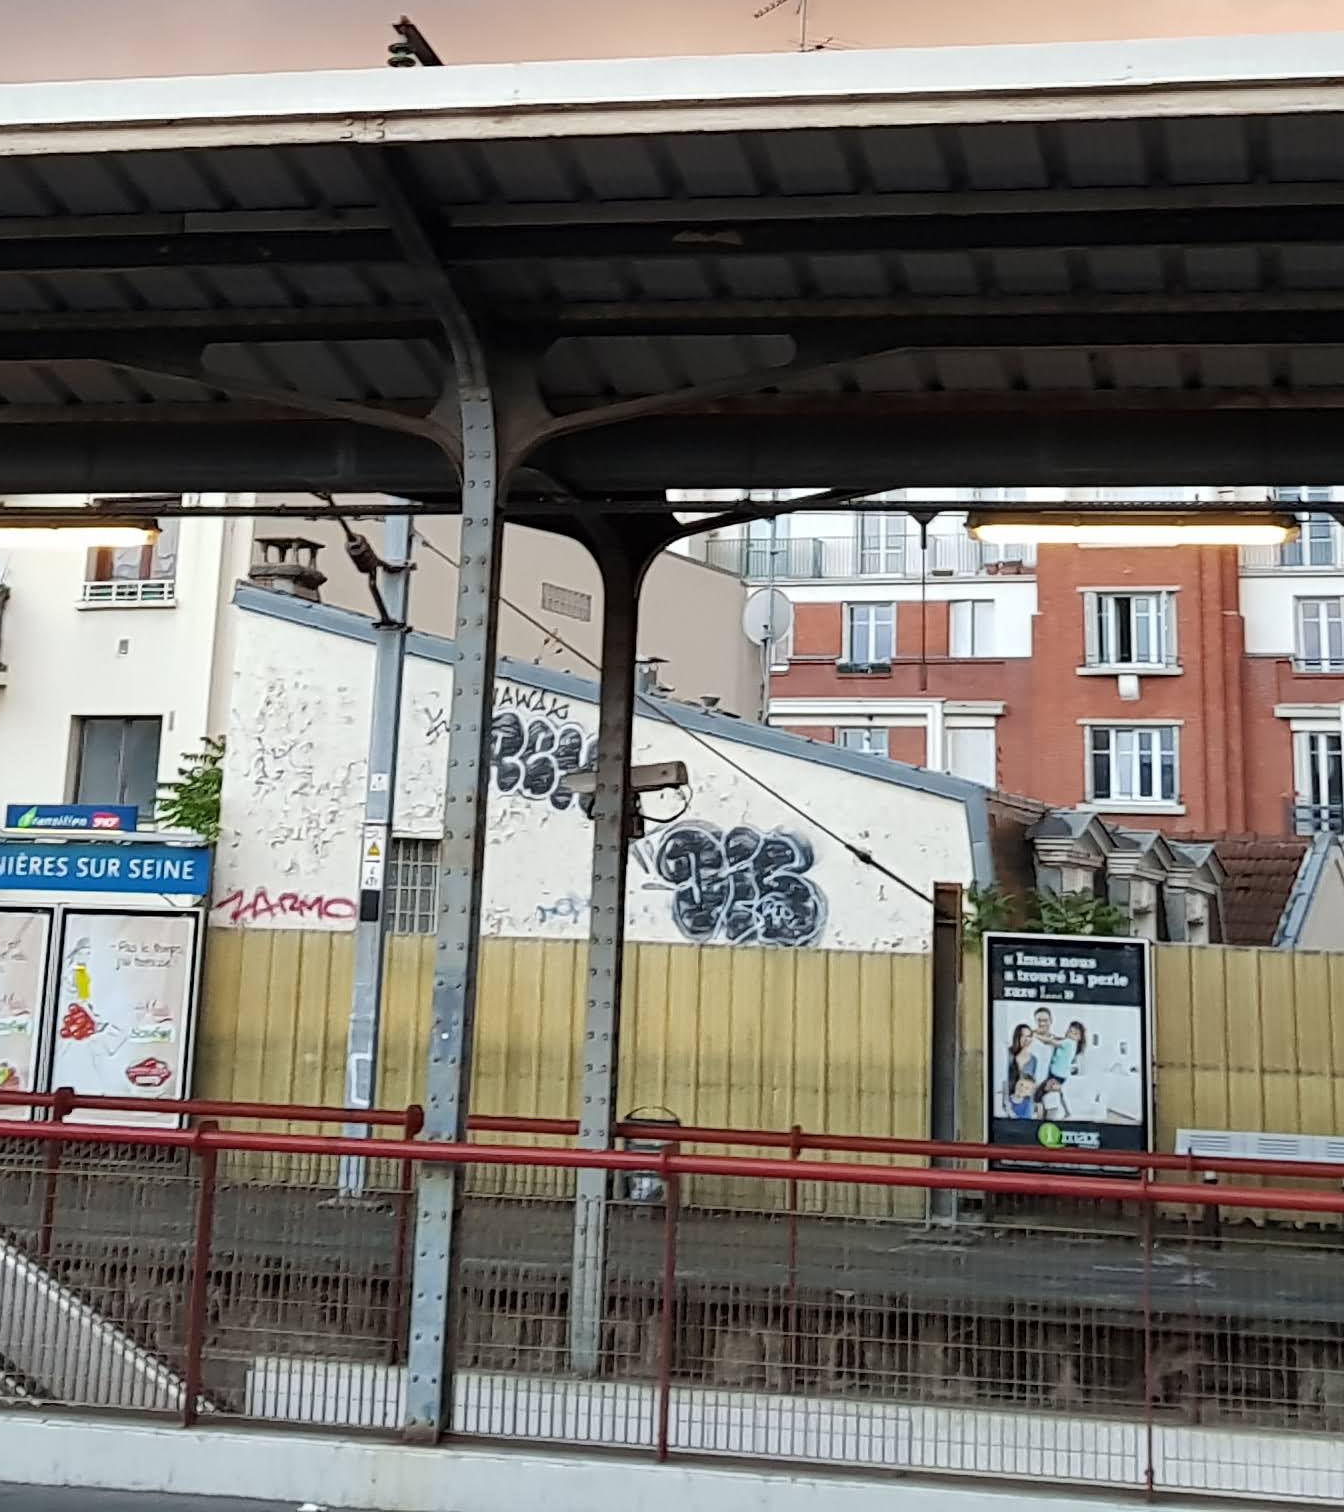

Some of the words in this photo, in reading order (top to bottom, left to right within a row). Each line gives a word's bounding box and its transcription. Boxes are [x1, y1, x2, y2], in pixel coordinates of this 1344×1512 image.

[75, 857, 121, 879] SUR
[128, 858, 196, 881] SEINE
[1059, 957, 1097, 969] nous
[1017, 970, 1066, 983] trouvé
[1068, 970, 1085, 985] la
[1087, 973, 1129, 988] perle
